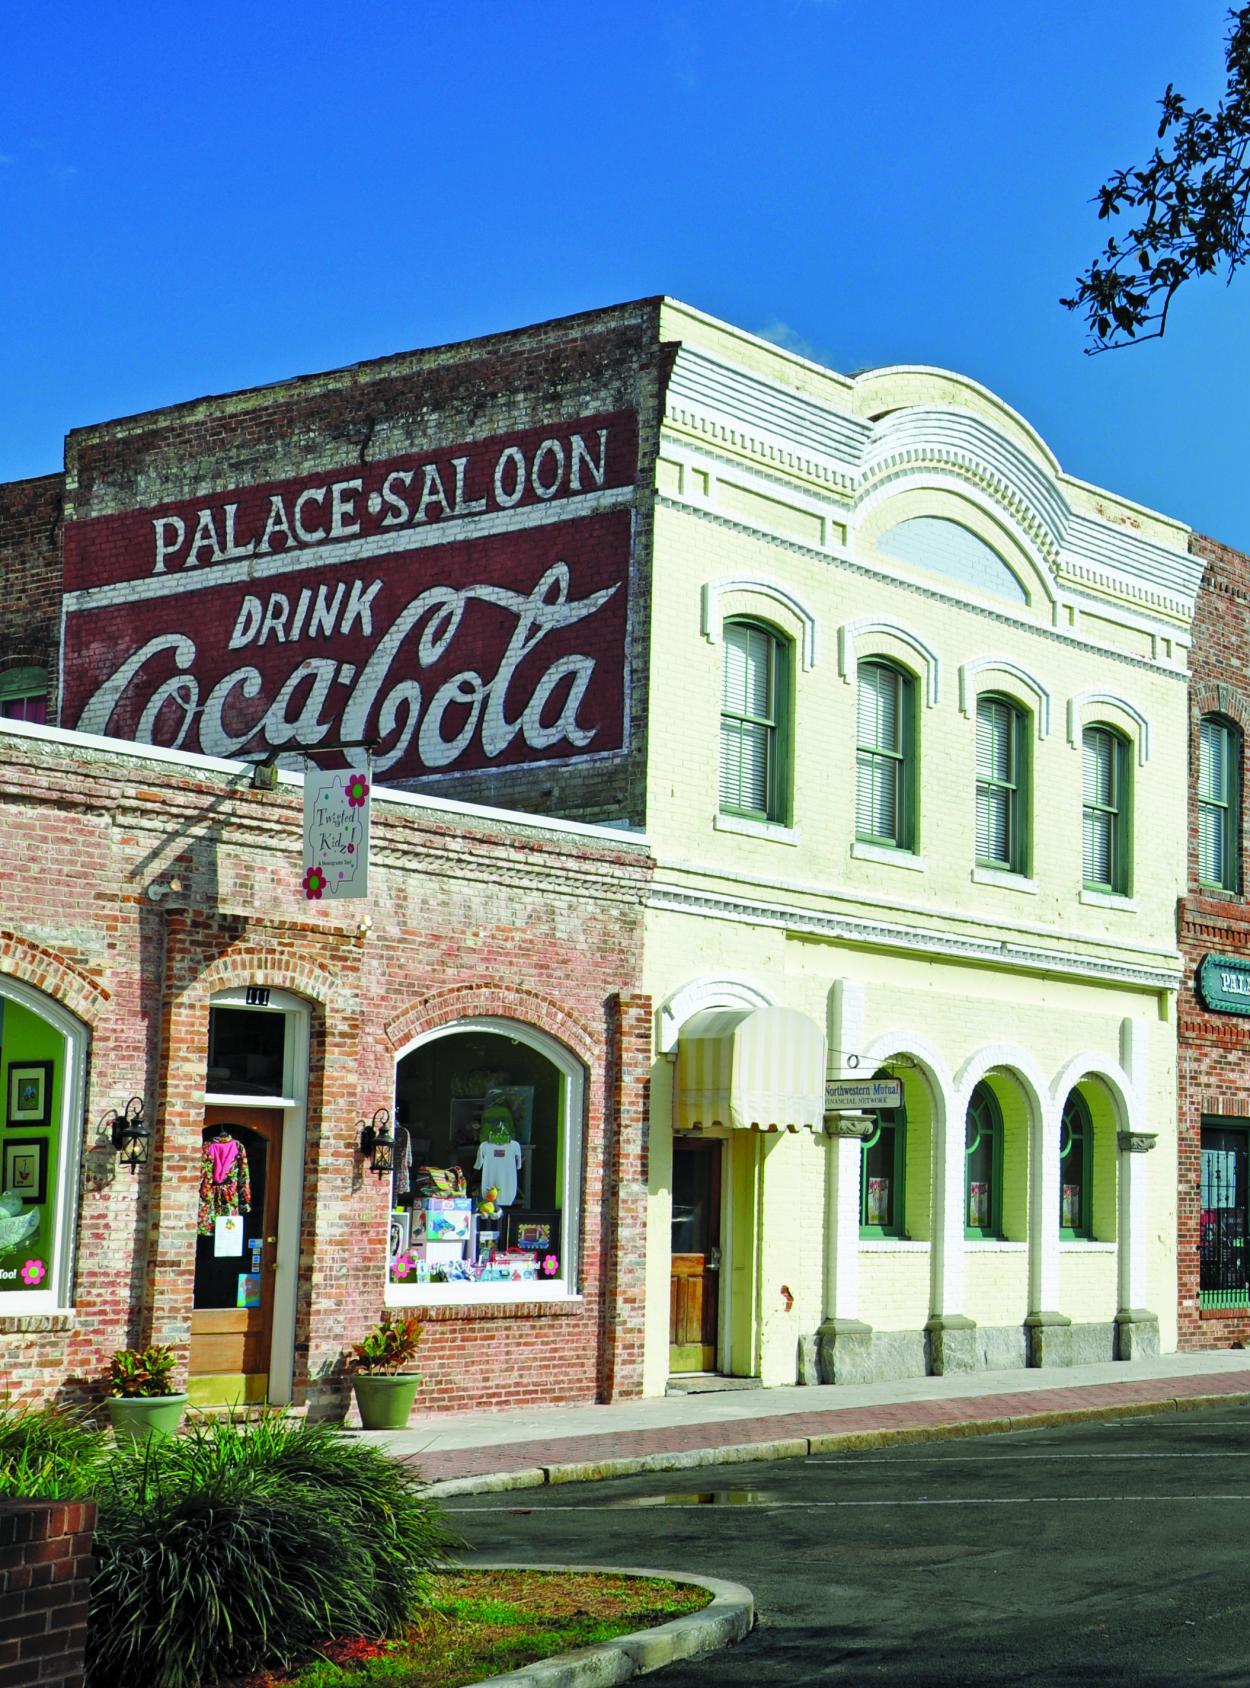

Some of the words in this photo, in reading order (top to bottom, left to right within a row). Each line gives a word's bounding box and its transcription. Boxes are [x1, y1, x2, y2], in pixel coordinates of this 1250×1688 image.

[228, 579, 383, 650] DRINK
[75, 561, 622, 775] Coca-Cola
[317, 807, 356, 827] Twisted
[247, 988, 268, 1005] 111
[825, 1084, 870, 1097] Northwestern
[873, 1083, 899, 1095] Mutual
[0, 1268, 17, 1280] Too!
